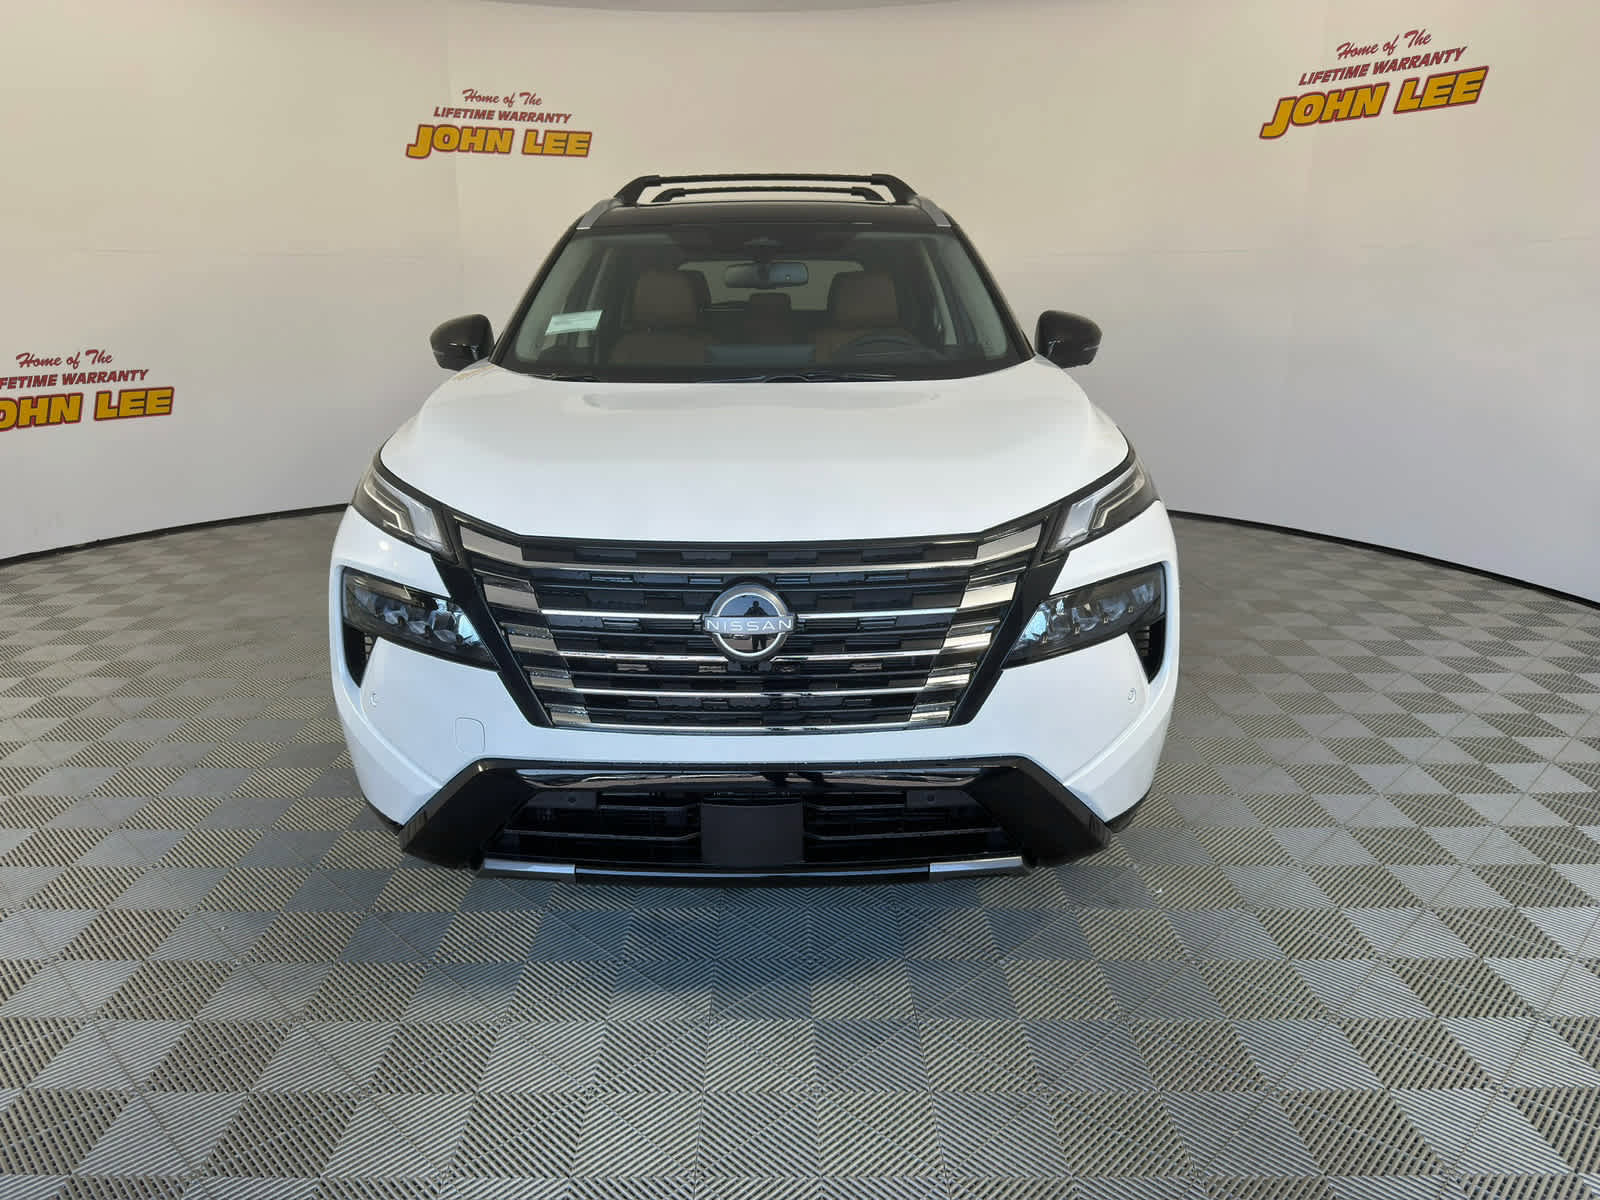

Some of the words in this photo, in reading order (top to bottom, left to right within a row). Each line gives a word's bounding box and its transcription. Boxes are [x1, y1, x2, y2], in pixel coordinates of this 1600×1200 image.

[1336, 42, 1379, 60] Home
[1382, 35, 1399, 56] of
[1404, 28, 1432, 48] The
[1298, 63, 1370, 86] LIFETIME
[1372, 46, 1467, 75] WARRANTY
[462, 88, 500, 104] Home
[502, 93, 515, 108] of
[519, 92, 542, 106] The
[1259, 81, 1390, 139] JOHN
[1393, 65, 1489, 114] LEE
[433, 106, 495, 120] LIFETIME
[498, 110, 572, 124] WARRANTY
[405, 124, 514, 159] JOHN
[521, 129, 592, 158] LEE
[16, 352, 62, 368] Home
[66, 352, 81, 370] of
[85, 349, 113, 365] The
[0, 374, 58, 390] FETIME
[62, 369, 149, 386] WARRANTY
[0, 393, 84, 432] OHN
[94, 386, 175, 421] LEE
[706, 618, 792, 632] NISSAN
